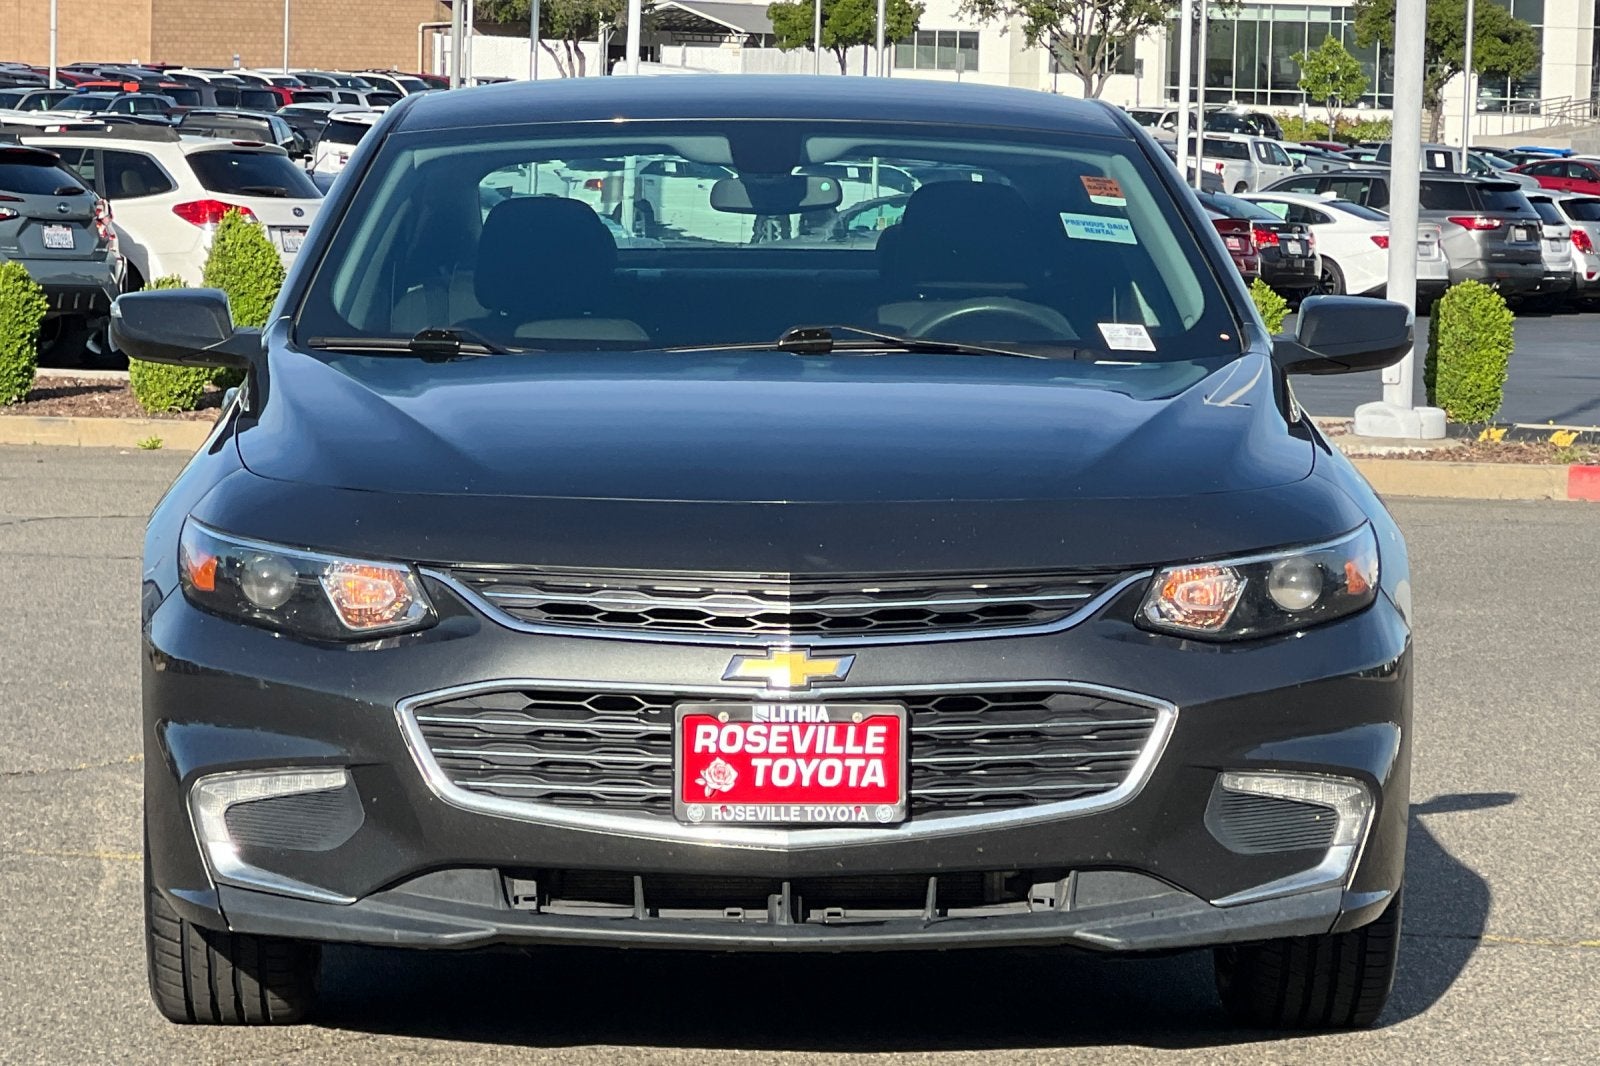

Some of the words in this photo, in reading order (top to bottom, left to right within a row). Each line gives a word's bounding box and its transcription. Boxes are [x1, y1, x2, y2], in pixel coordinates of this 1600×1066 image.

[1065, 219, 1105, 229] PREVIOUS
[1106, 222, 1129, 231] DAILY
[1084, 227, 1116, 236] RENTAL
[771, 706, 830, 723] LITHIA
[693, 725, 888, 754] ROSEVILLE
[751, 758, 886, 788] TOYOTA
[711, 806, 801, 822] ROSEVILLE
[804, 806, 869, 822] TOYOTA
